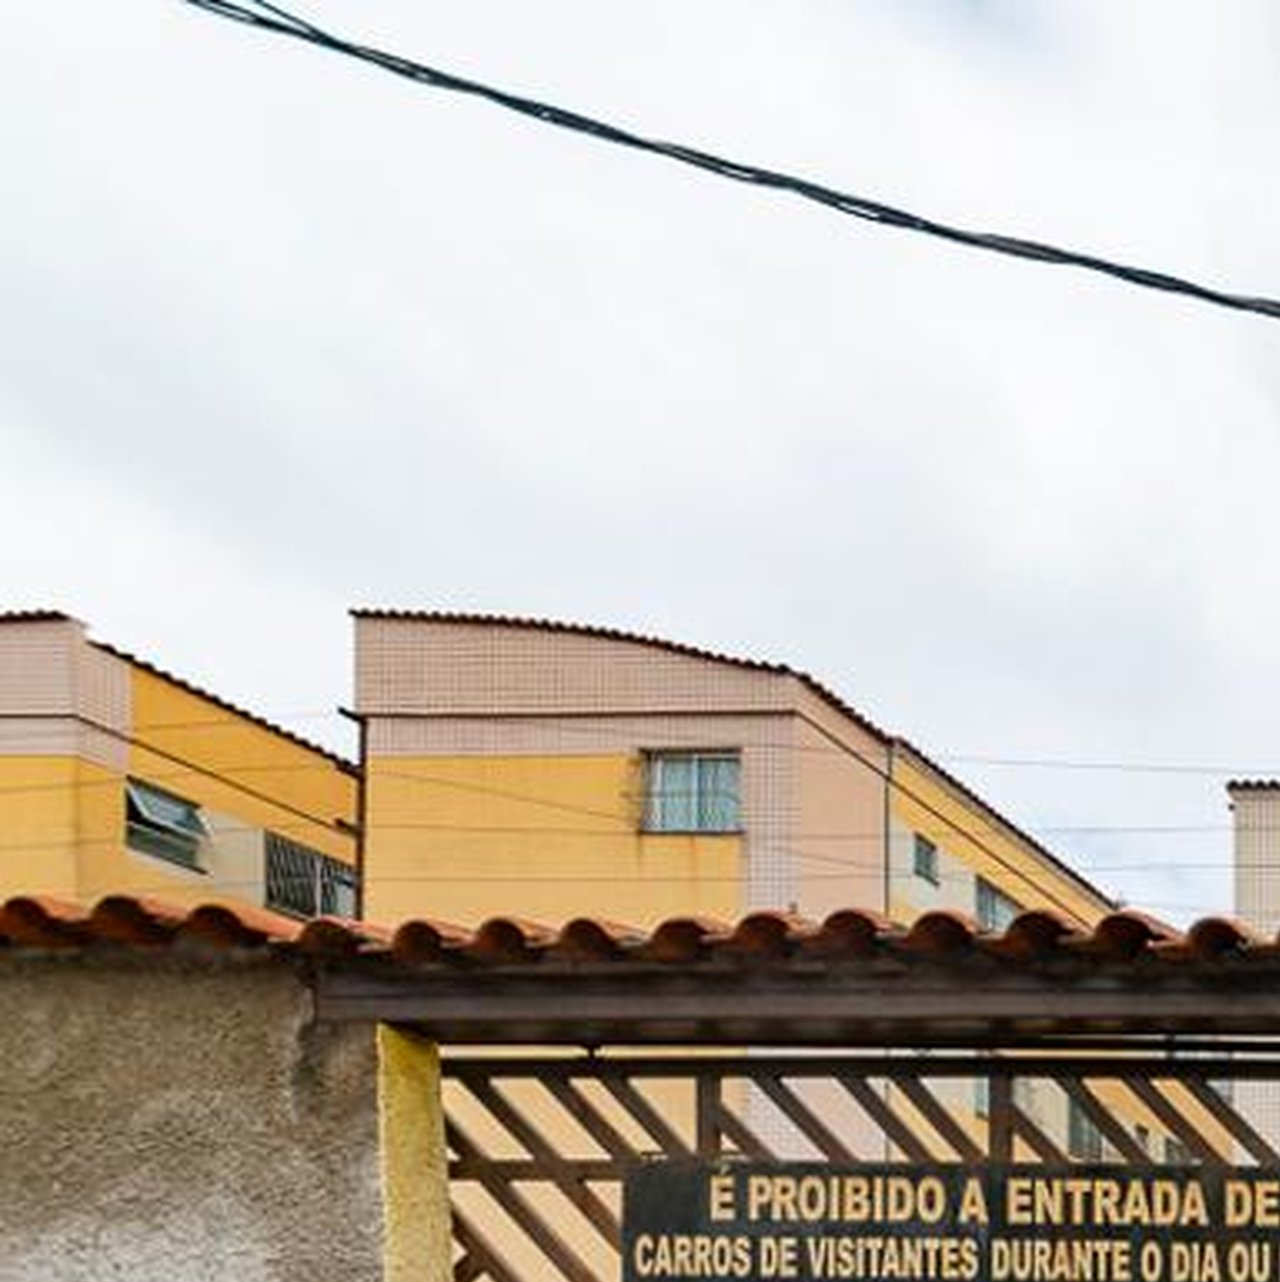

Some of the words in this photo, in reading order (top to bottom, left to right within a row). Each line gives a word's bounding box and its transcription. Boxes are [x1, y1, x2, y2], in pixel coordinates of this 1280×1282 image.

[709, 1164, 736, 1222] É
[748, 1175, 946, 1223] PROIBIDO
[959, 1177, 989, 1224] A
[1007, 1178, 1209, 1226] ENTRADA
[634, 1234, 752, 1277] CARROS
[760, 1236, 798, 1278] DE
[807, 1236, 979, 1280] VISITANTES
[991, 1239, 1132, 1282] DURANTE
[1140, 1241, 1163, 1282] O
